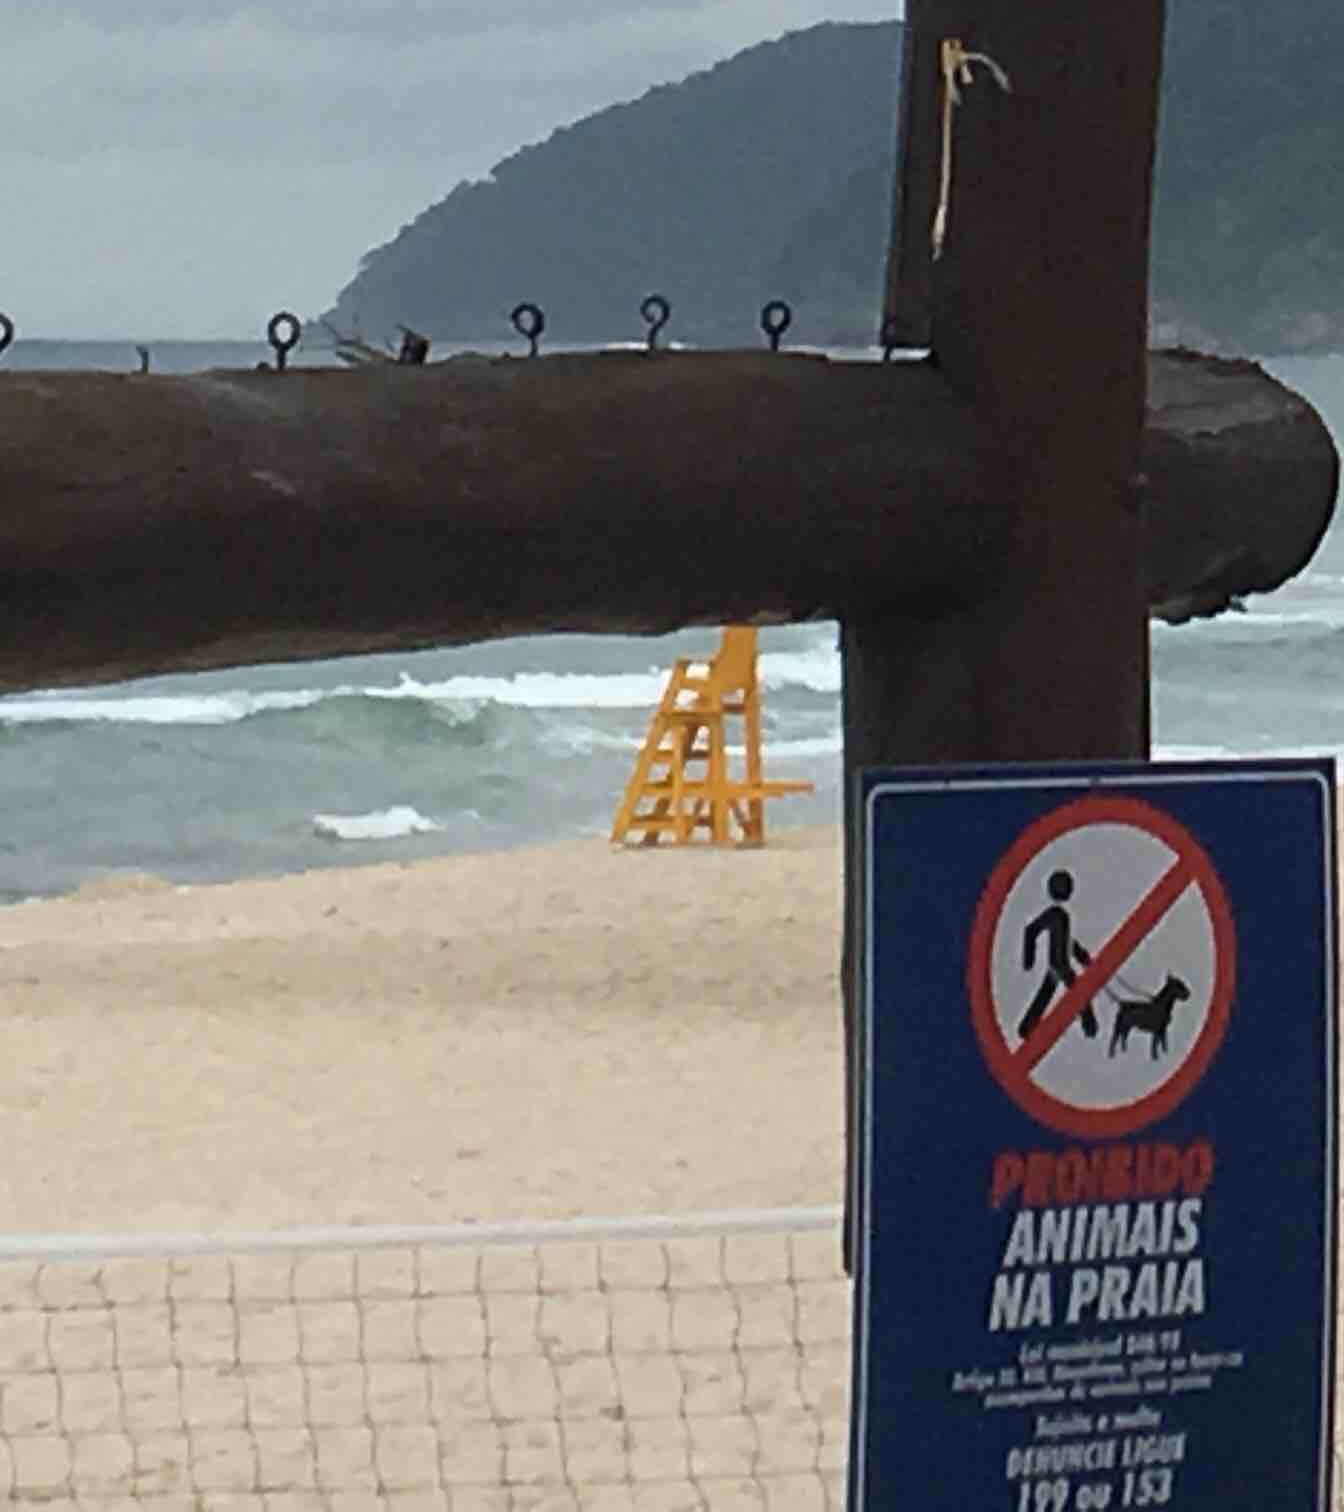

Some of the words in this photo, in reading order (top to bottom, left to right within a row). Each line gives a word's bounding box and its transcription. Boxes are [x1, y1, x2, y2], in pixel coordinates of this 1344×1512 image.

[990, 1141, 1215, 1208] PROIBIDO
[1003, 1197, 1202, 1267] ANIMAIS
[989, 1272, 1051, 1331] NA
[1066, 1259, 1204, 1323] PRAIA
[1006, 1439, 1116, 1479] DENUNCIE
[1122, 1433, 1185, 1466] LIGUE
[1018, 1477, 1069, 1512] 199
[1076, 1484, 1111, 1510] ou
[1122, 1468, 1172, 1507] 153
